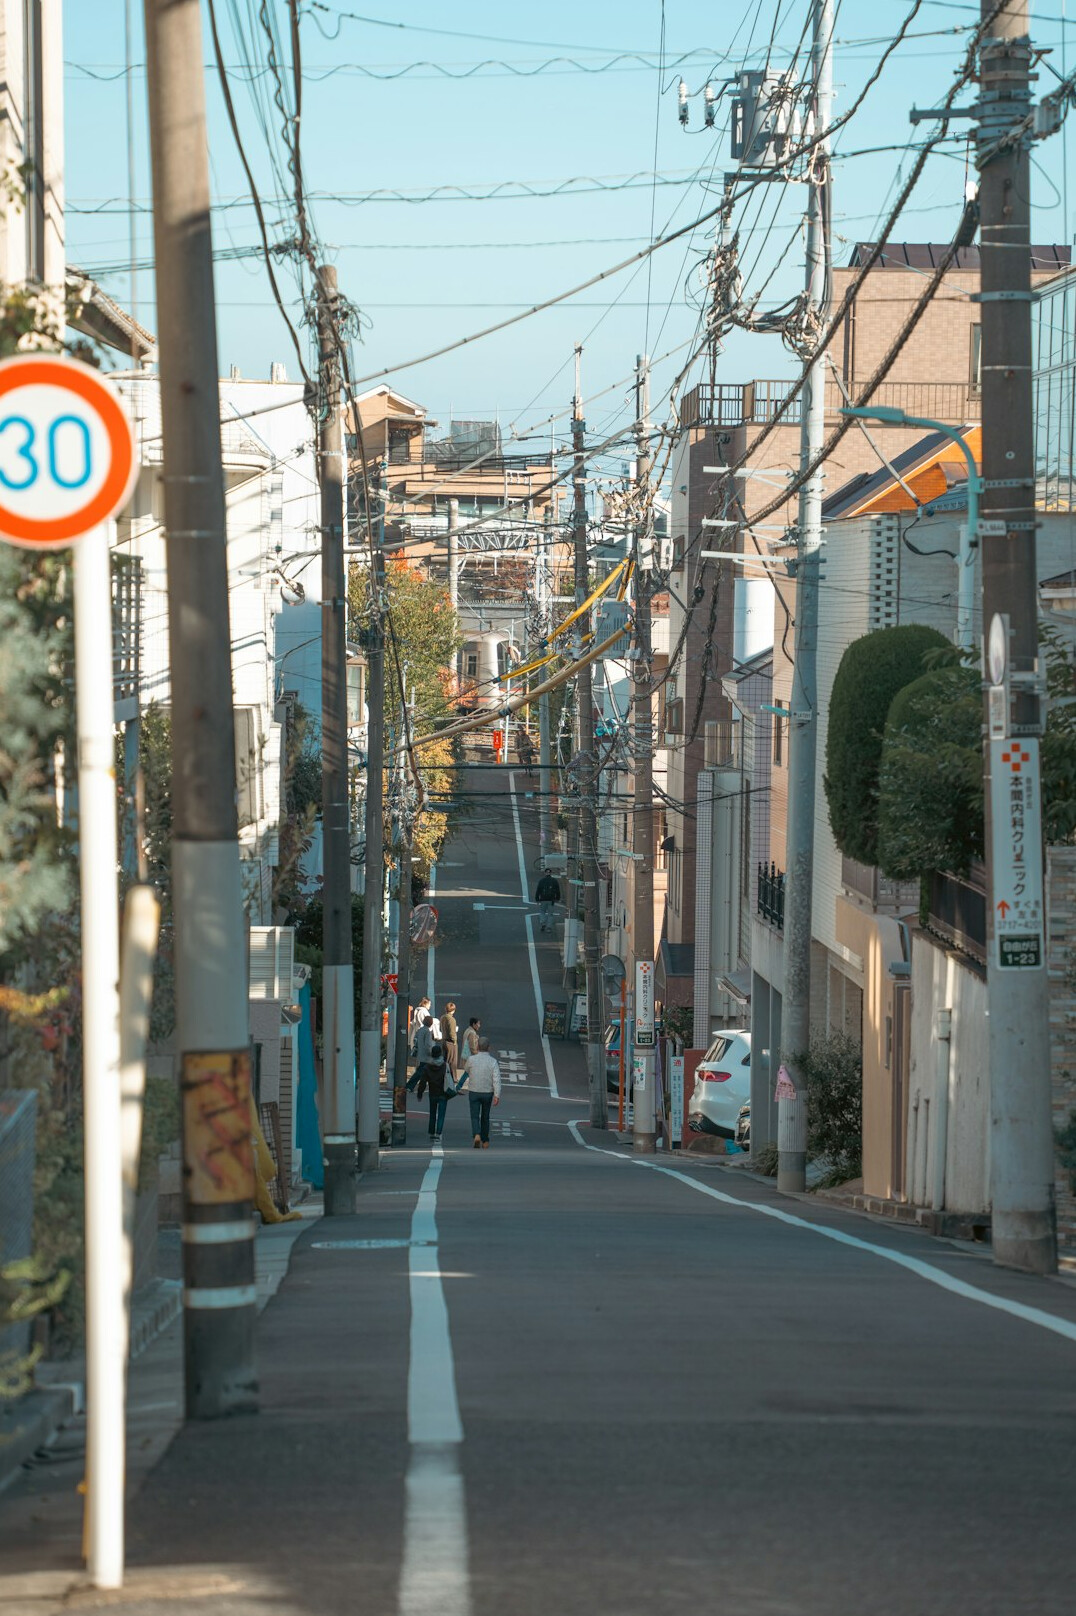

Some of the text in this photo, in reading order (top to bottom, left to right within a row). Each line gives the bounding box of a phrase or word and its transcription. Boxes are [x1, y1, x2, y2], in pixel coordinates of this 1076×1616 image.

[0, 414, 91, 490] 30
[1010, 775, 1026, 896] 本間内科クリニック
[1007, 954, 1036, 965] 1-23
